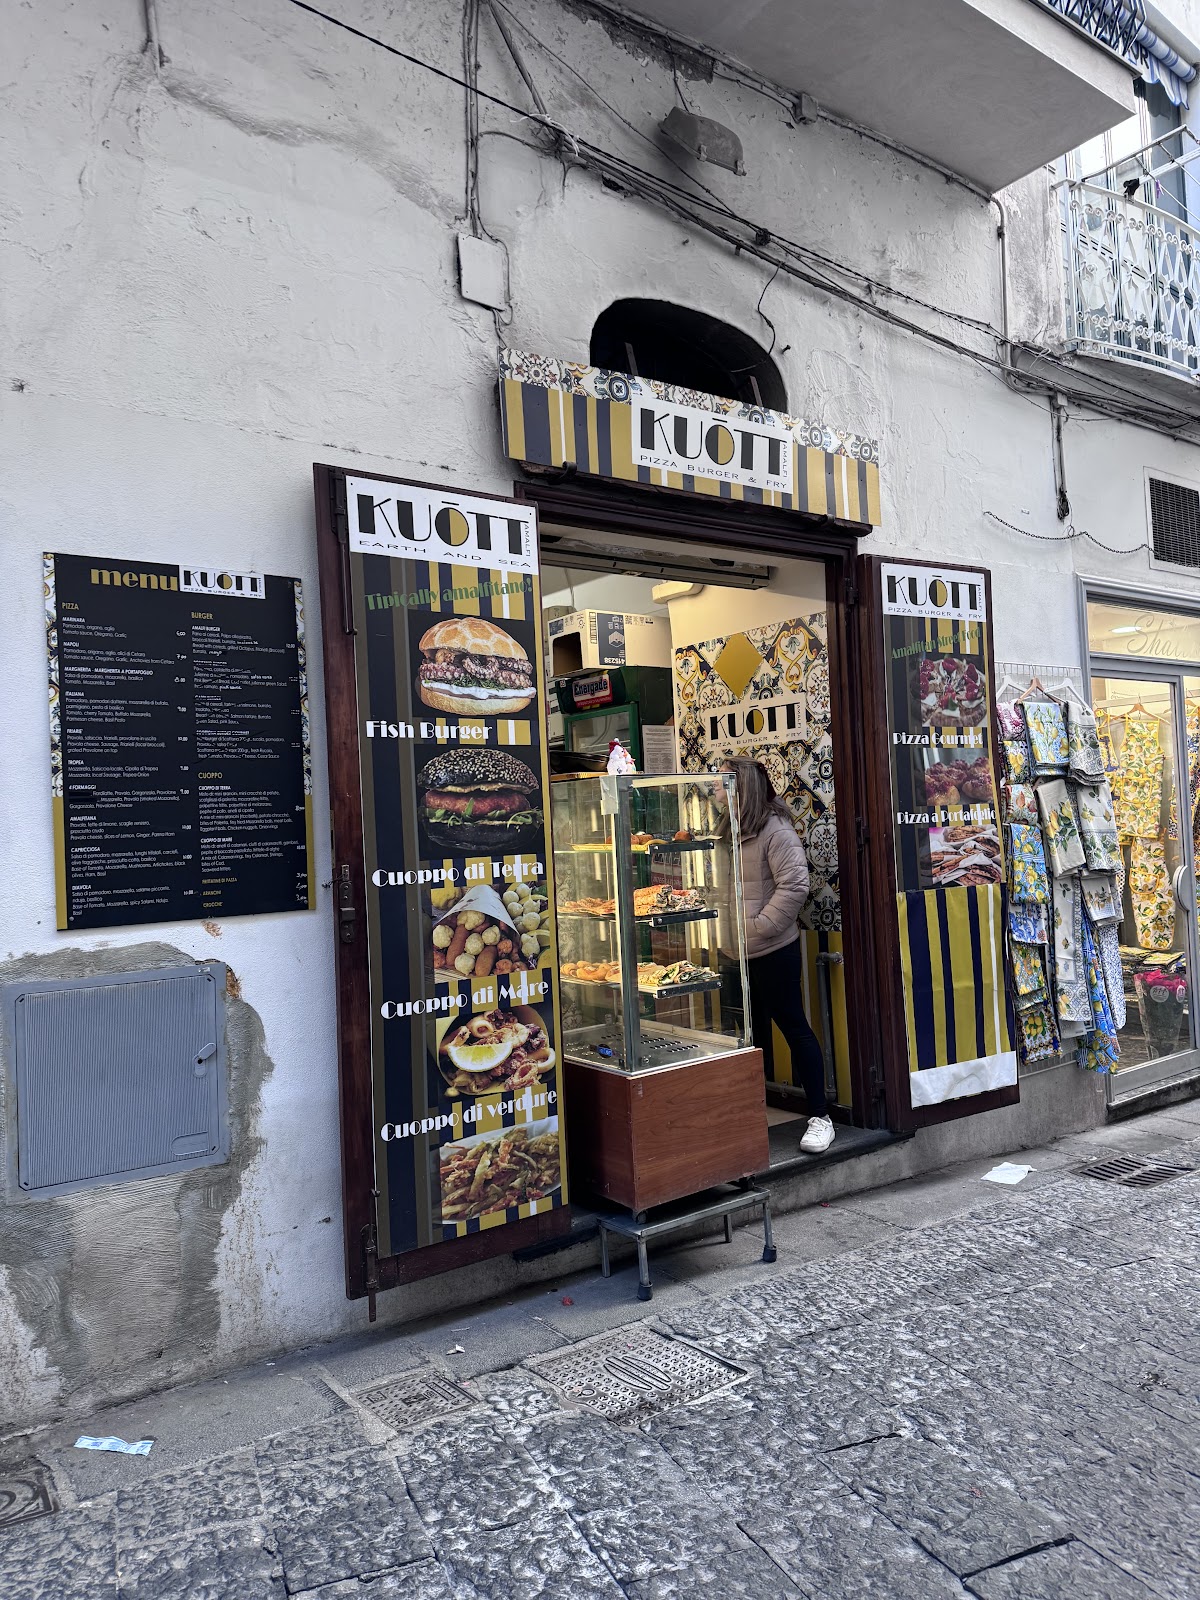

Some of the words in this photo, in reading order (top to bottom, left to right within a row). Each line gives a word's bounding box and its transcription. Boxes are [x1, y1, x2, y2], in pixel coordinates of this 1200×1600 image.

[640, 454, 678, 468] PIZZA
[687, 464, 739, 480] BURGER
[748, 476, 757, 484] &
[766, 479, 787, 489] FRY
[523, 523, 531, 557] AMALFI
[359, 540, 426, 554] EARTH
[443, 551, 482, 562] AND
[498, 558, 531, 568] SEA
[90, 568, 178, 591] menu
[364, 588, 439, 611] Tipically
[442, 577, 533, 603] amalfitano!
[191, 612, 213, 620] BURGER
[888, 606, 912, 614] PIZZA
[918, 609, 952, 617] BURGER
[891, 638, 936, 660] Amalfitan
[937, 631, 961, 652] Street
[575, 679, 608, 697] Energade
[366, 720, 414, 739] Fish
[420, 721, 493, 740] Burger
[736, 736, 768, 745] BURGER
[893, 732, 929, 746] Pizza
[931, 731, 983, 747] Gourmet
[897, 811, 930, 825] Pizza
[931, 812, 939, 824] a
[371, 866, 459, 888] Cuoppo
[464, 862, 485, 880] di
[489, 858, 544, 878] Terra
[380, 990, 468, 1019] Cuoppo
[471, 983, 493, 1004] di
[498, 978, 550, 1002] Mare
[380, 1110, 459, 1142] Cuoppo
[463, 1102, 484, 1123] di
[486, 1089, 557, 1118] verdure
